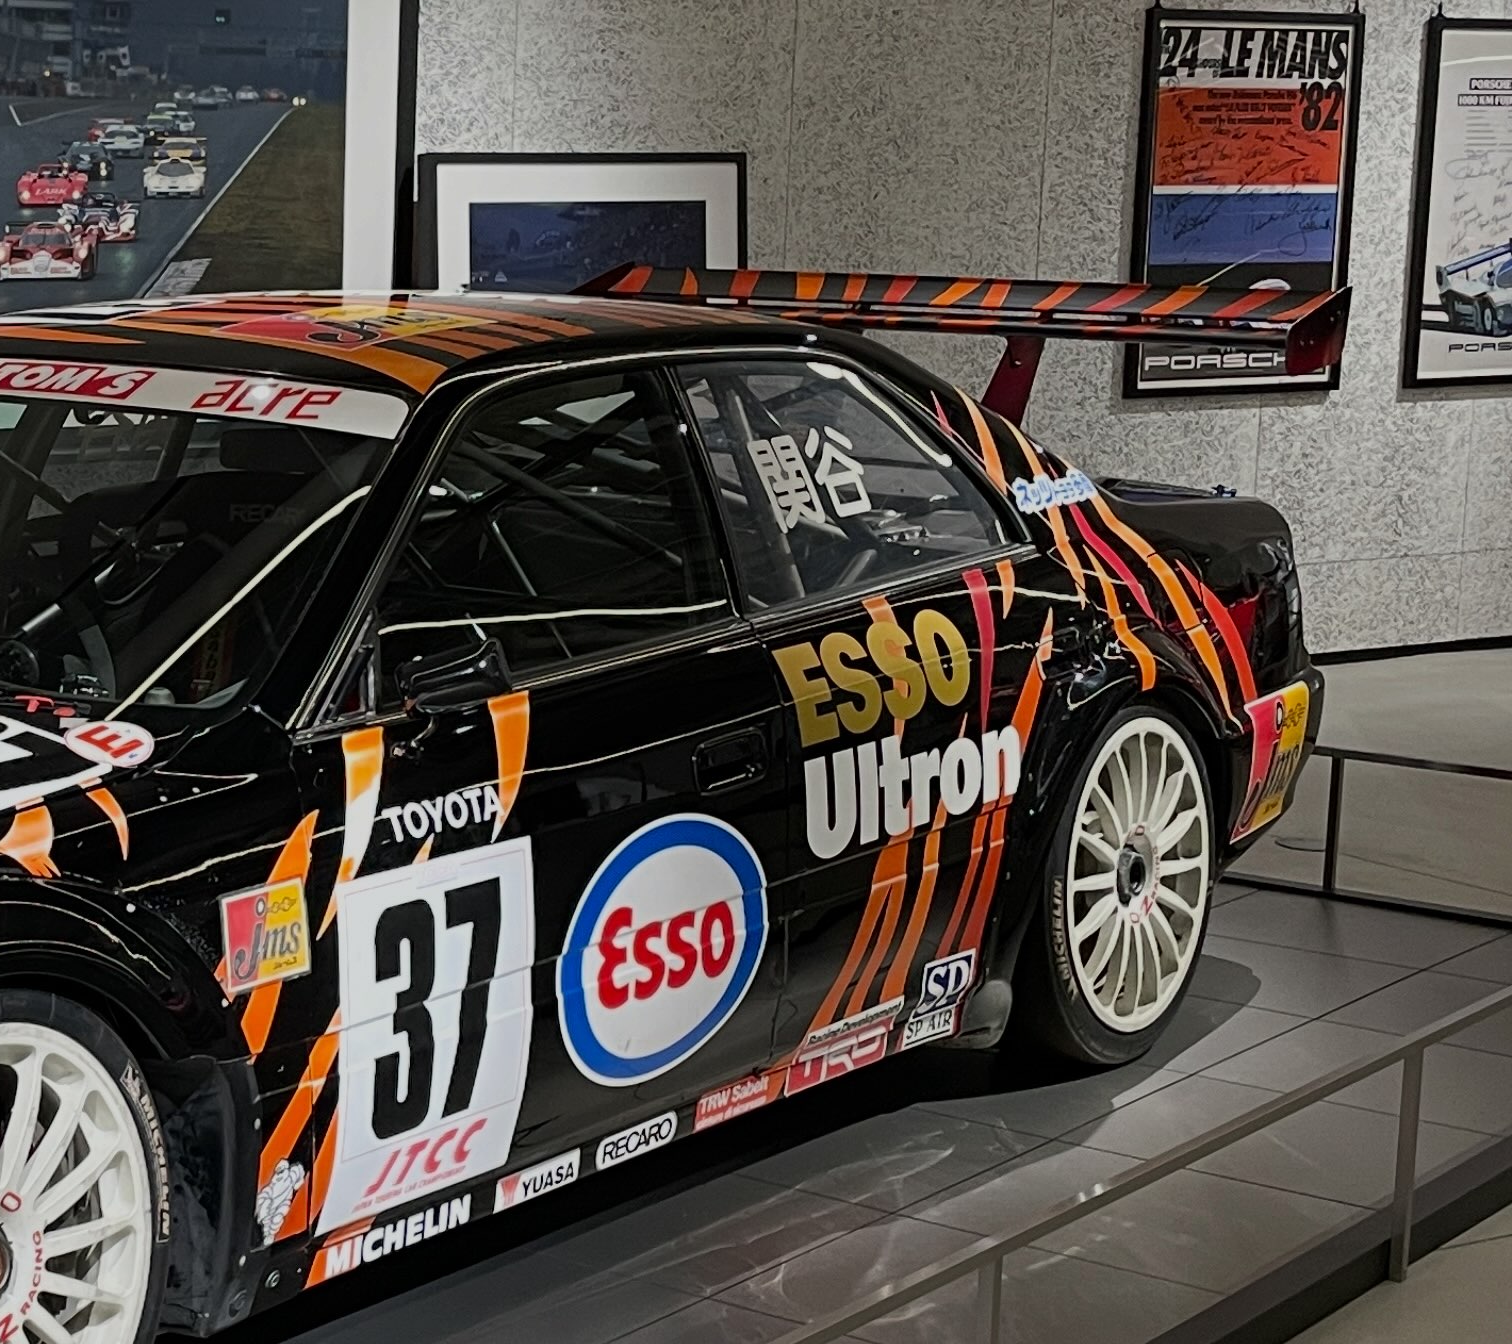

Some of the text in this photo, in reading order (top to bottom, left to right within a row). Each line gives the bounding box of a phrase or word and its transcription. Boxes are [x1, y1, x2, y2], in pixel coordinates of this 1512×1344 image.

[1160, 29, 1349, 79] 24 LE MANS
[748, 426, 872, 535] 関谷
[772, 609, 970, 748] ESSO
[383, 785, 504, 843] TOYOTA
[804, 725, 1021, 860] Ultron
[371, 876, 502, 1140] 37
[906, 1010, 953, 1040] SP AIR
[363, 1117, 488, 1198] JTCC
[521, 1159, 576, 1197] YUASA
[601, 1116, 673, 1165] RECARO
[326, 1193, 472, 1280] MICHELIN
